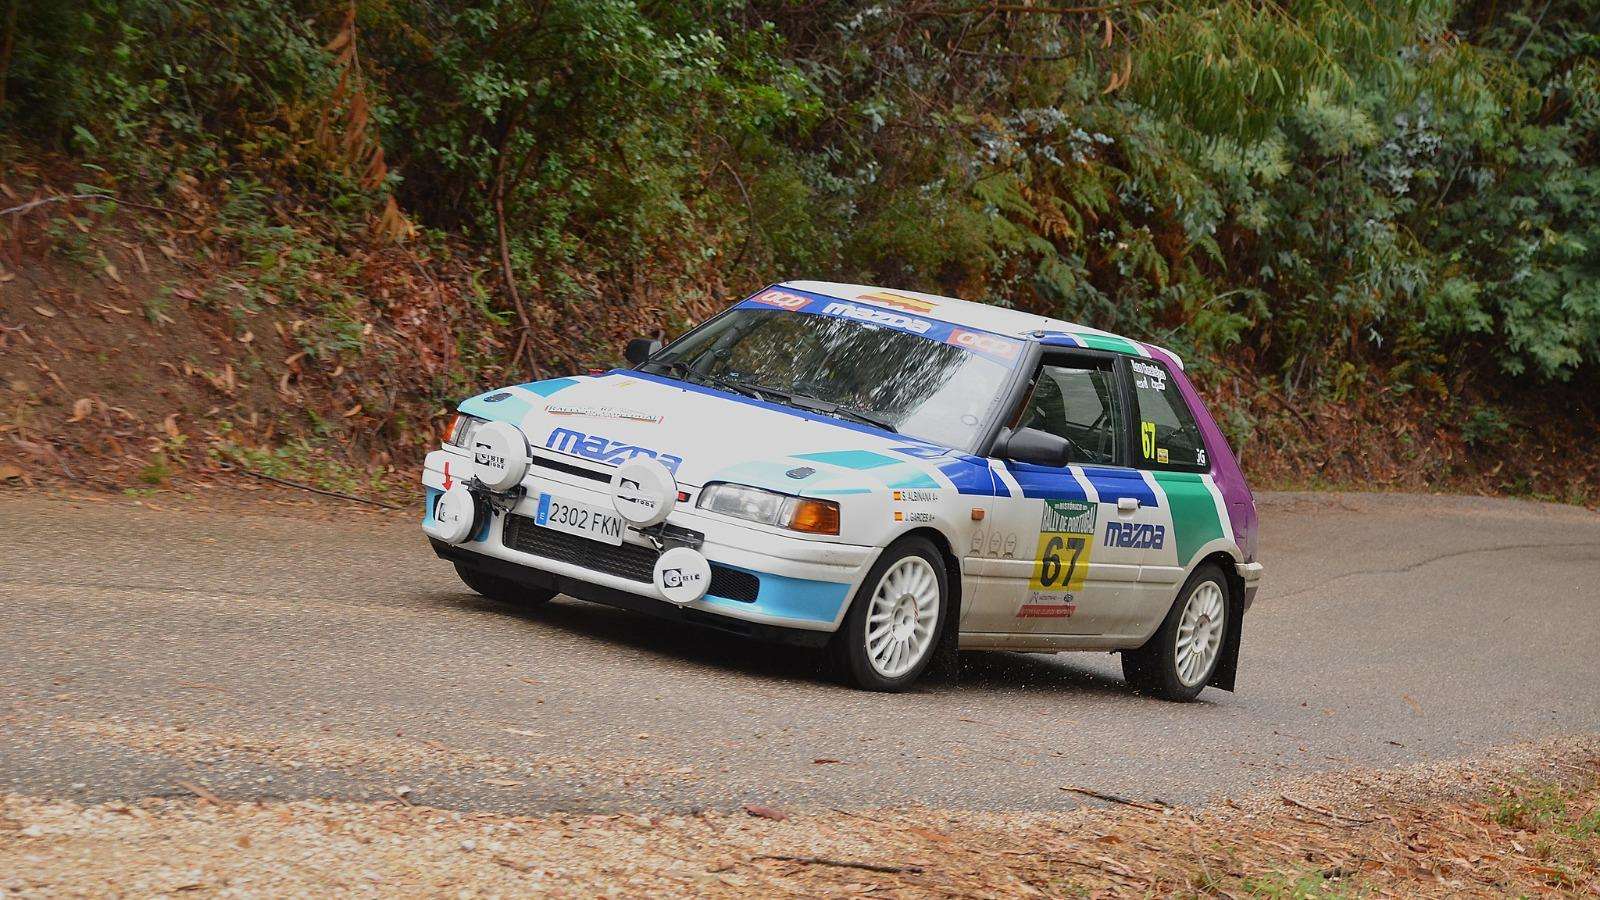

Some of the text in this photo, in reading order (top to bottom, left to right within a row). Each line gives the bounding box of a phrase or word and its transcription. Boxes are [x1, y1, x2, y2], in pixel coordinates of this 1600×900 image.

[1141, 421, 1156, 459] 67
[539, 502, 622, 538] E 2302 FKN
[1041, 500, 1097, 533] RALLY DE PORTUGAL
[1040, 536, 1086, 587] 67
